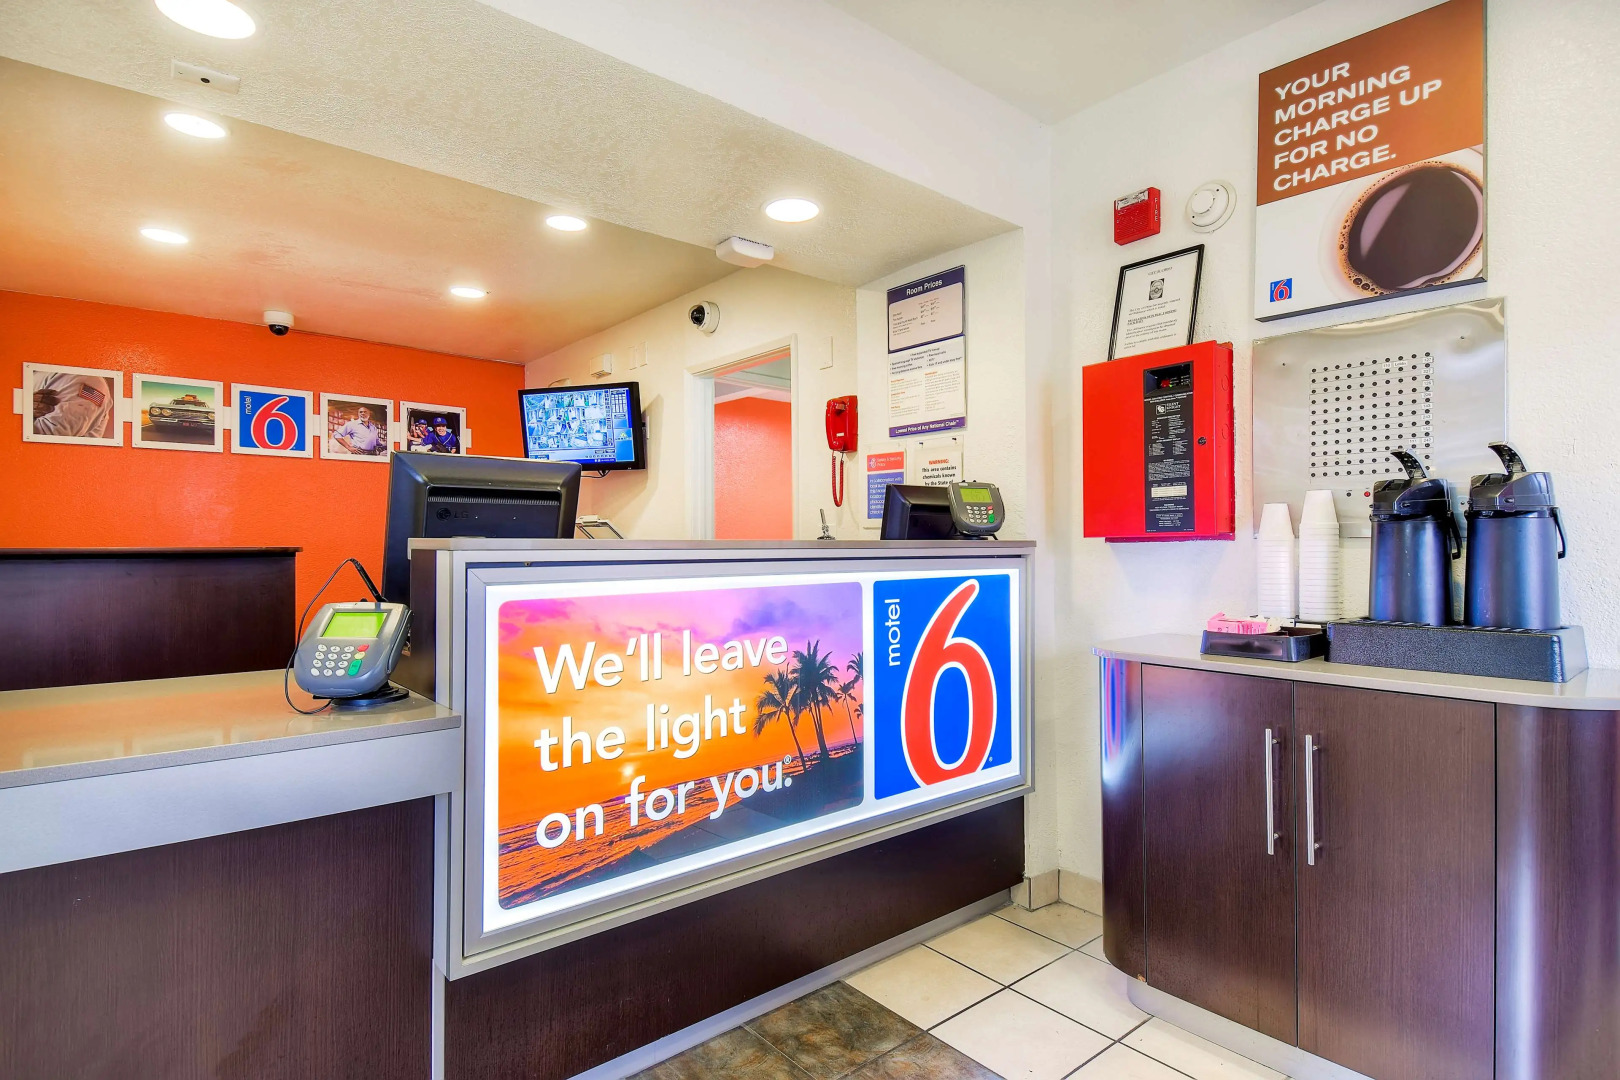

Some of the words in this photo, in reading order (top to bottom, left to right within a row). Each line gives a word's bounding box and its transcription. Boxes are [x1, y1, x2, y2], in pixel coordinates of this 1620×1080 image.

[1274, 62, 1351, 101] YOUR
[1274, 65, 1411, 125] MORNING
[1274, 95, 1391, 146] CHARGE
[1399, 79, 1442, 106] UP
[1273, 144, 1397, 192] CHARGE.
[1274, 140, 1328, 170] FOR
[1336, 124, 1379, 151] NO
[906, 286, 923, 296] Room
[923, 280, 943, 291] Prices
[1273, 279, 1290, 301] 6
[251, 396, 298, 451] 6
[453, 511, 469, 519] LG
[885, 598, 900, 667] motel
[533, 631, 663, 695] We'll
[682, 629, 789, 677] leave
[901, 578, 997, 787] 6
[534, 716, 626, 772] the
[645, 695, 747, 759] light
[535, 803, 604, 848] on
[624, 775, 695, 827] for
